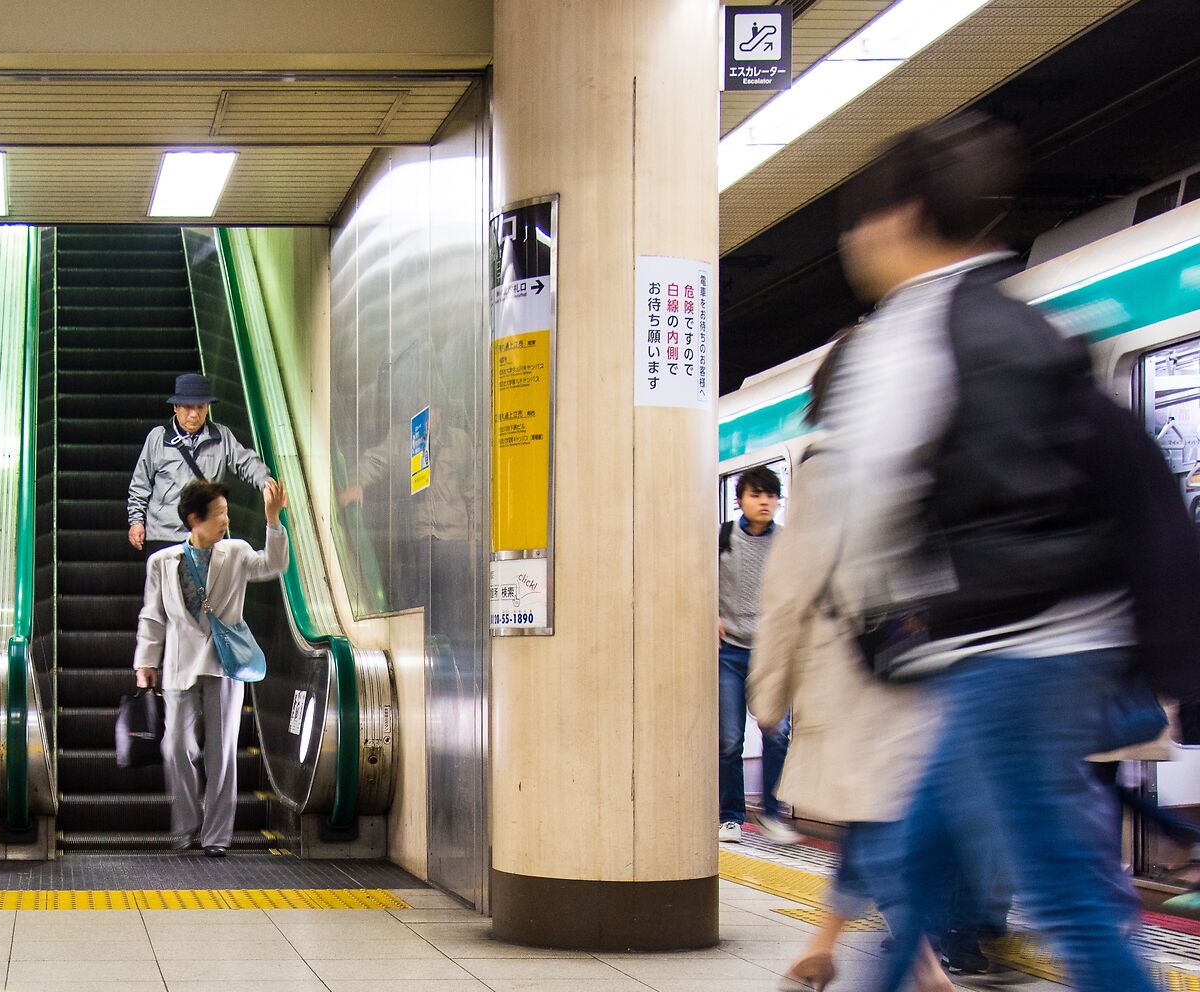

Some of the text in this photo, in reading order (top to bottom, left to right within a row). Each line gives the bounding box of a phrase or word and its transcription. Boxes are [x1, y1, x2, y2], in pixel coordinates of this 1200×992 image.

[729, 66, 786, 77] エスカレーター
[647, 282, 661, 390] お待ち願います
[666, 283, 679, 376] 白線の内側で
[683, 284, 695, 376] 危険ですので
[501, 587, 515, 598] 検索
